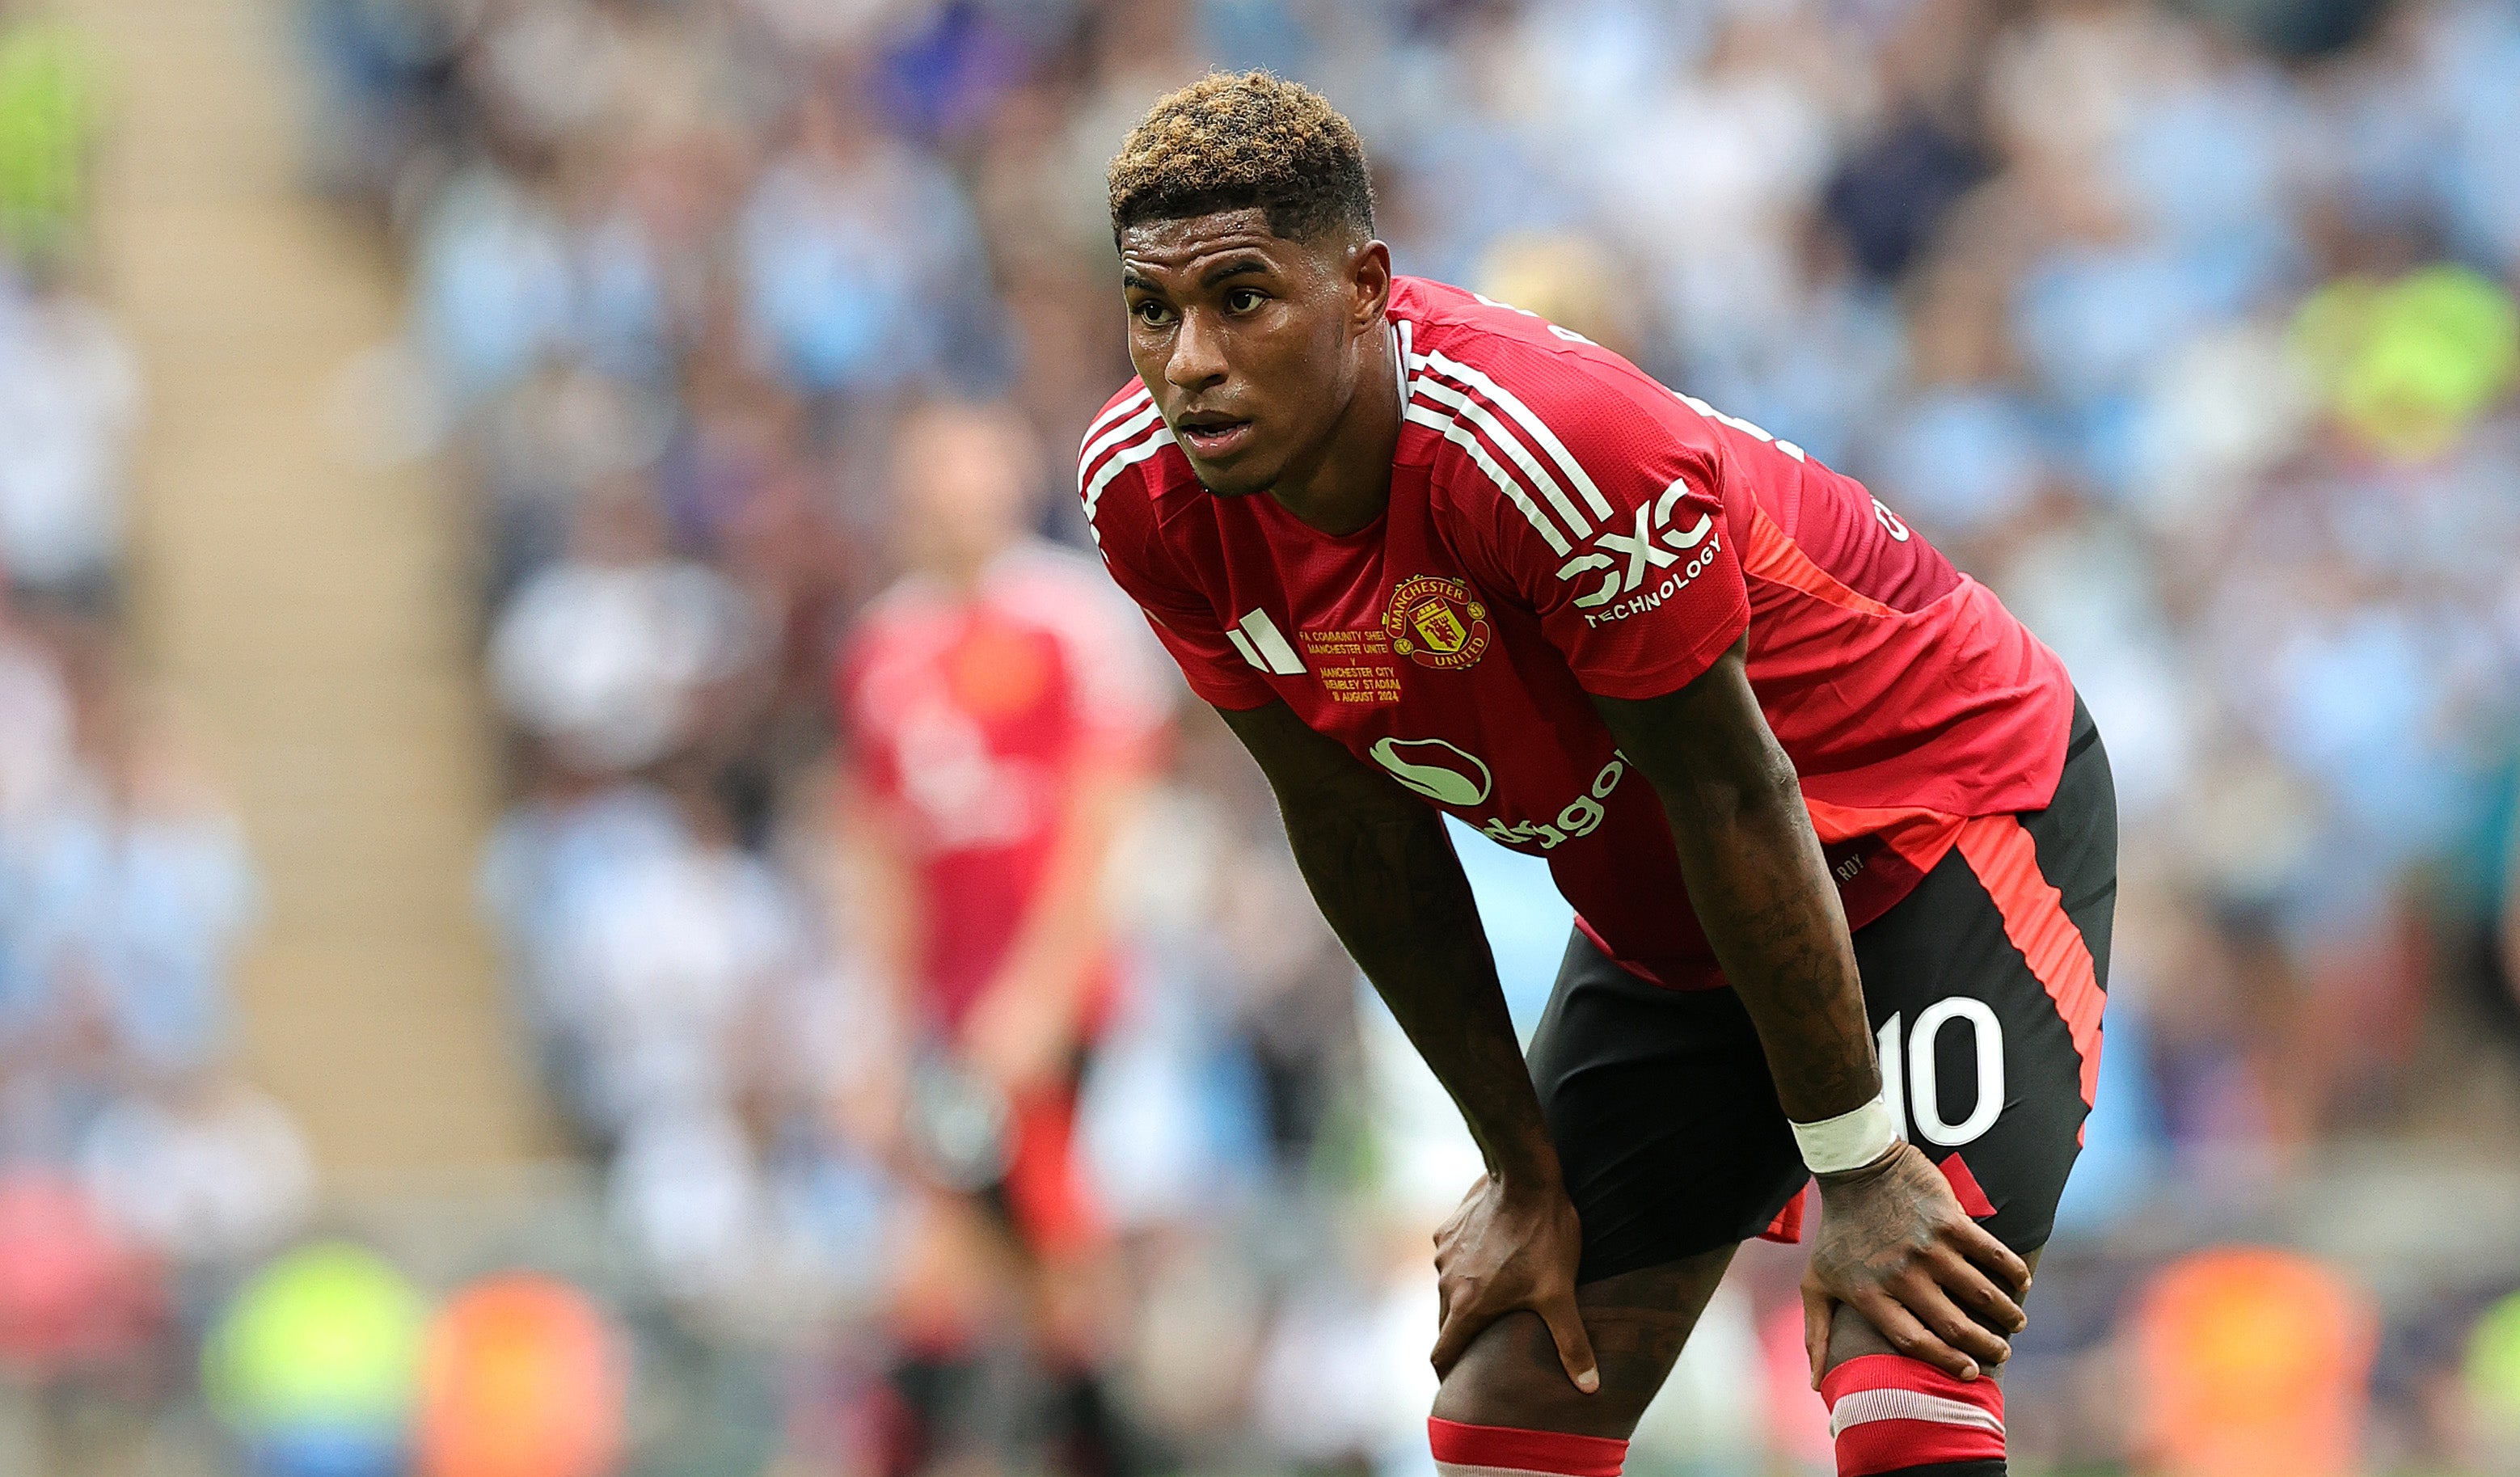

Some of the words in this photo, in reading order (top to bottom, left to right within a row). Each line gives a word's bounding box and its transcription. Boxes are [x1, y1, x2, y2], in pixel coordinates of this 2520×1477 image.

[1584, 532, 1721, 629] TECHNOLOGY
[1391, 581, 1463, 630] MANCHESTER
[1307, 644, 1361, 654] MANCHESTER
[1362, 644, 1388, 654] UNITE
[1434, 637, 1484, 666] UNITED
[1320, 667, 1374, 678] MANCHESTER
[1375, 667, 1395, 677] CITY
[1323, 680, 1359, 690] WEMBLEY
[1362, 679, 1401, 690] STADIUM
[1342, 691, 1374, 703] AUGUST
[1377, 690, 1399, 702] 2024
[1876, 996, 2005, 1146] 10
